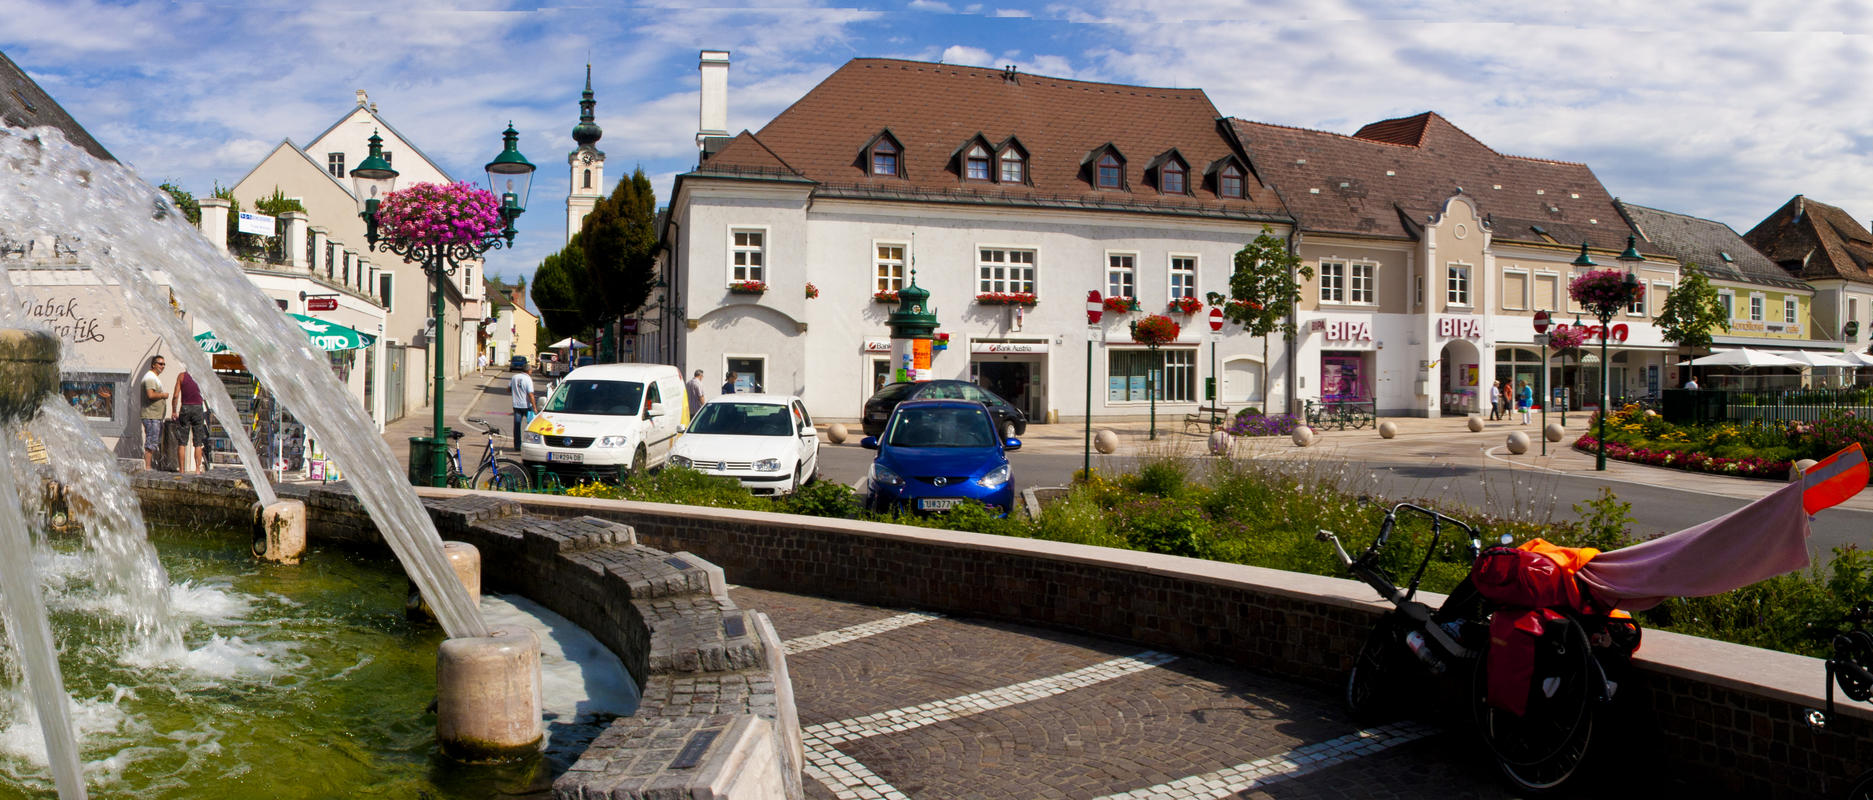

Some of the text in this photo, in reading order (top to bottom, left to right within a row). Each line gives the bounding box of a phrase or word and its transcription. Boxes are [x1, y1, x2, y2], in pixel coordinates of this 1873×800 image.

[1326, 321, 1373, 341] BIPA
[1439, 318, 1482, 337] BIPA
[996, 344, 1032, 352] Bank Austria
